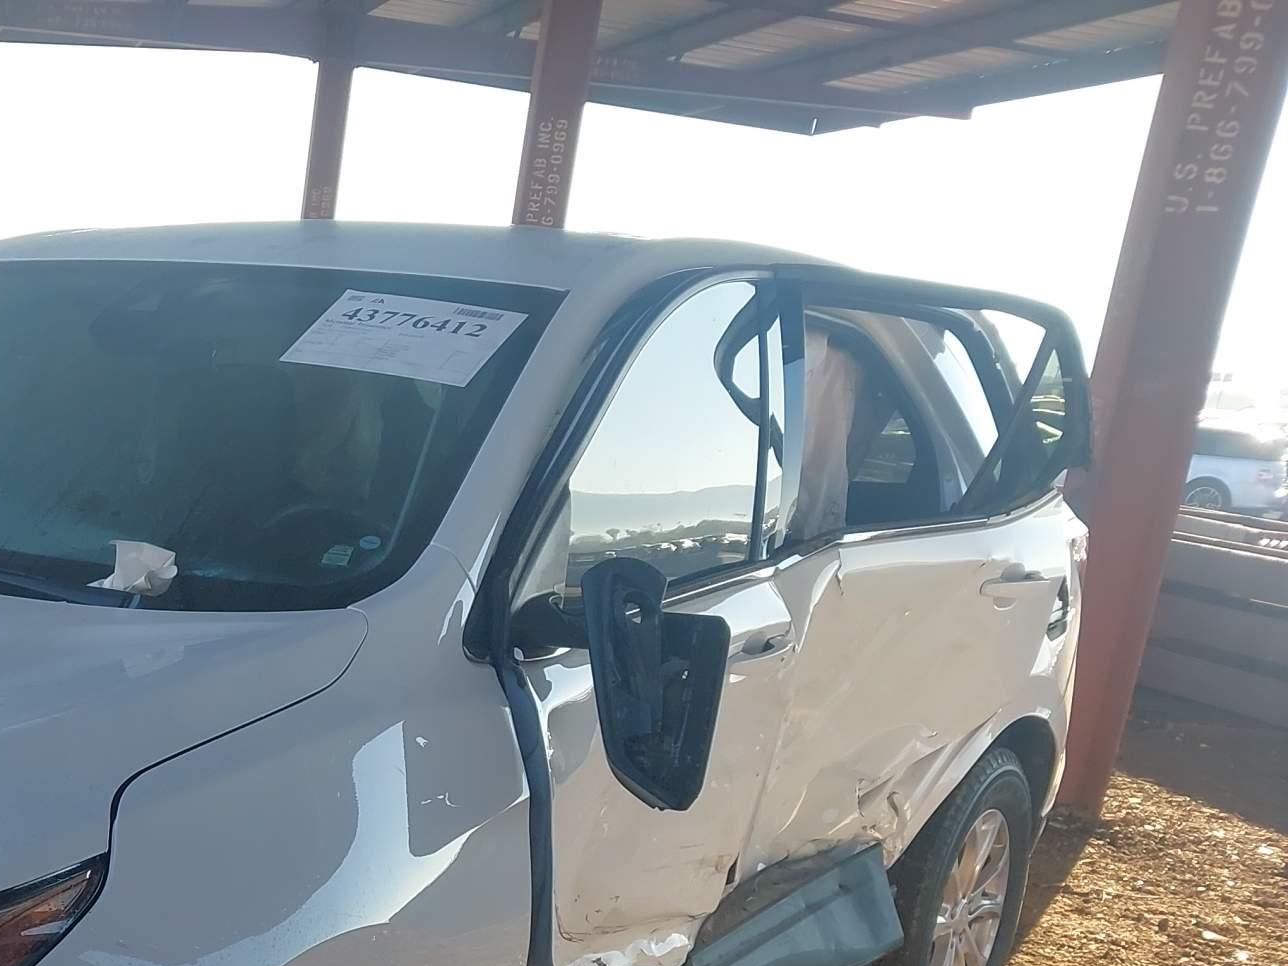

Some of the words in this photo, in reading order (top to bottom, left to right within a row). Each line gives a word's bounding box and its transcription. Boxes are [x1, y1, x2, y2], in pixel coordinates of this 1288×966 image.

[1164, 153, 1203, 214] U.S.
[1185, 0, 1242, 132] PREFAB
[527, 158, 548, 223] PREFAB
[341, 306, 488, 338] 43776412
